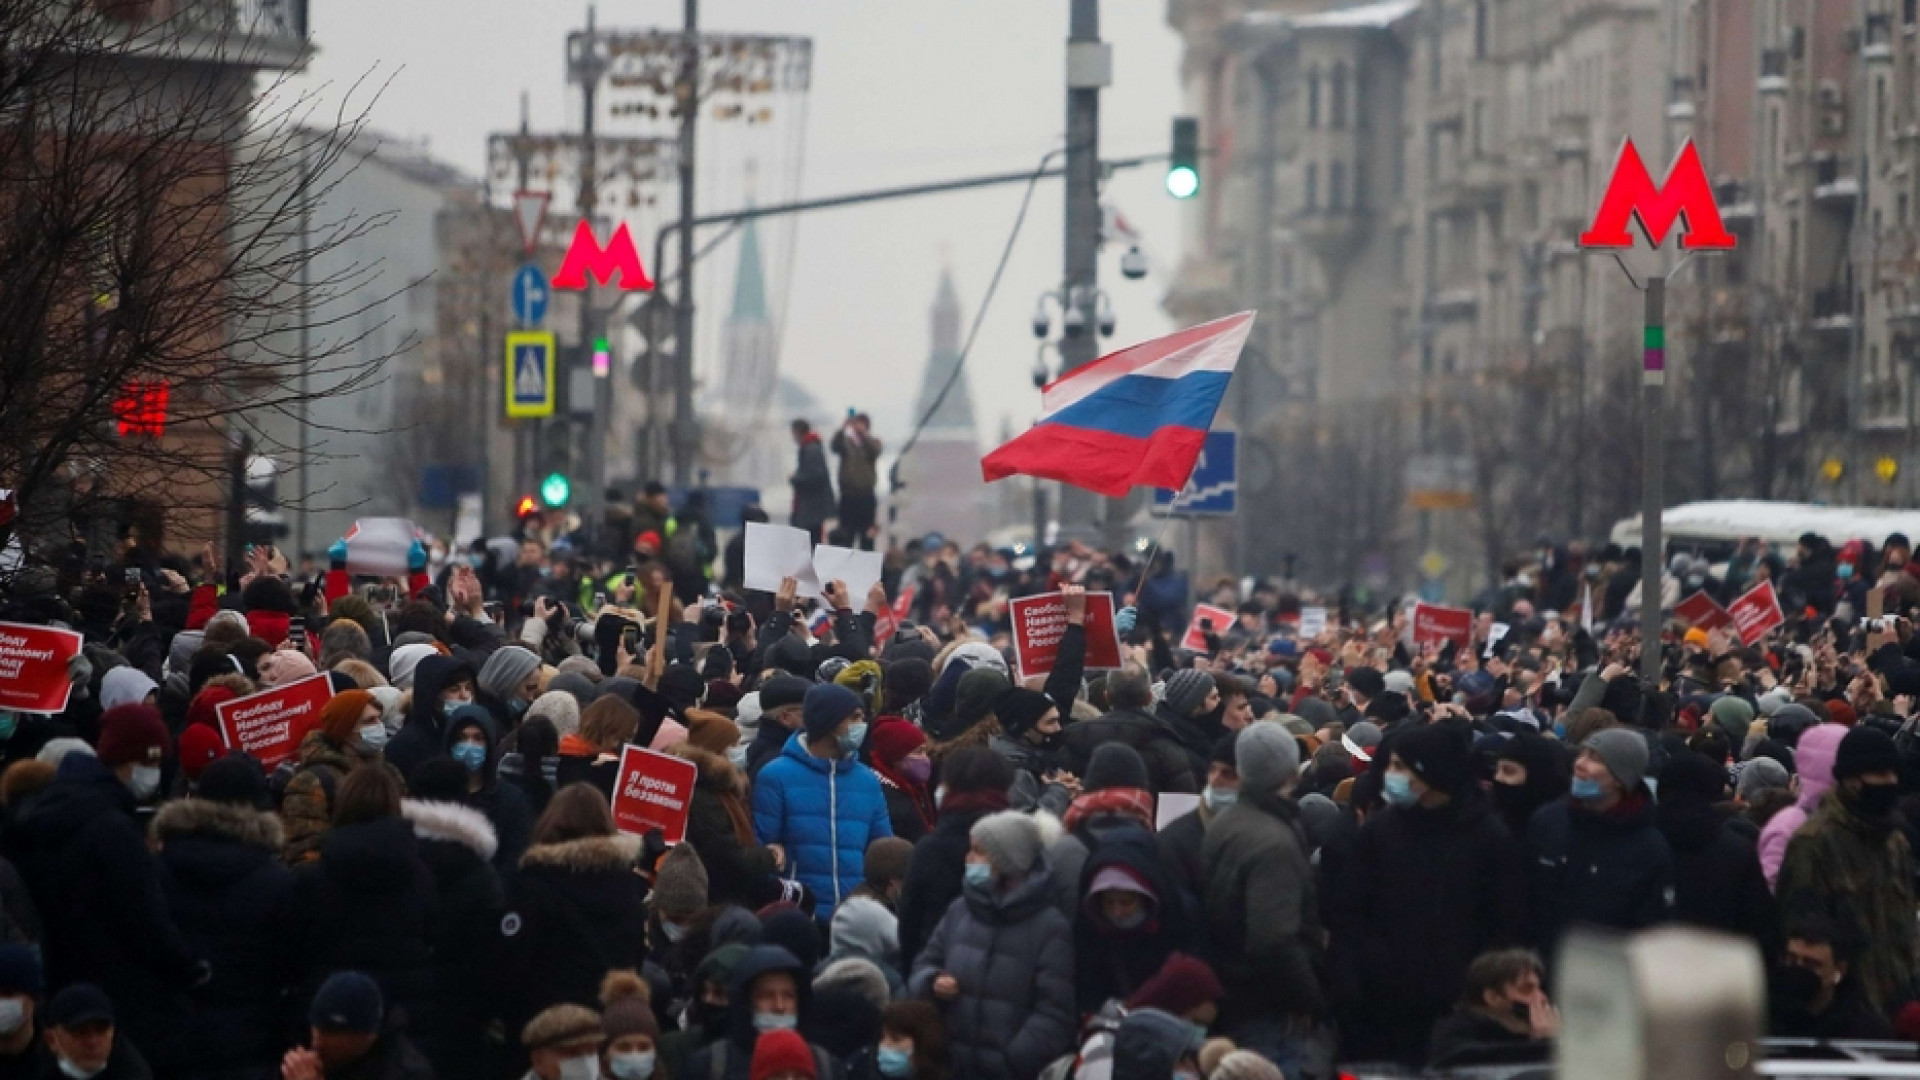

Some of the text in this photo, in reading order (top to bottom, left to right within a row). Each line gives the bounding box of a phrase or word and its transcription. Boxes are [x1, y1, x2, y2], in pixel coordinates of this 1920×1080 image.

[232, 700, 284, 720] Свободу
[236, 701, 311, 731] Навальному!
[239, 721, 289, 742] Свободу
[242, 733, 288, 752] России!
[627, 770, 676, 794] Я против
[625, 785, 683, 811] беззакония
